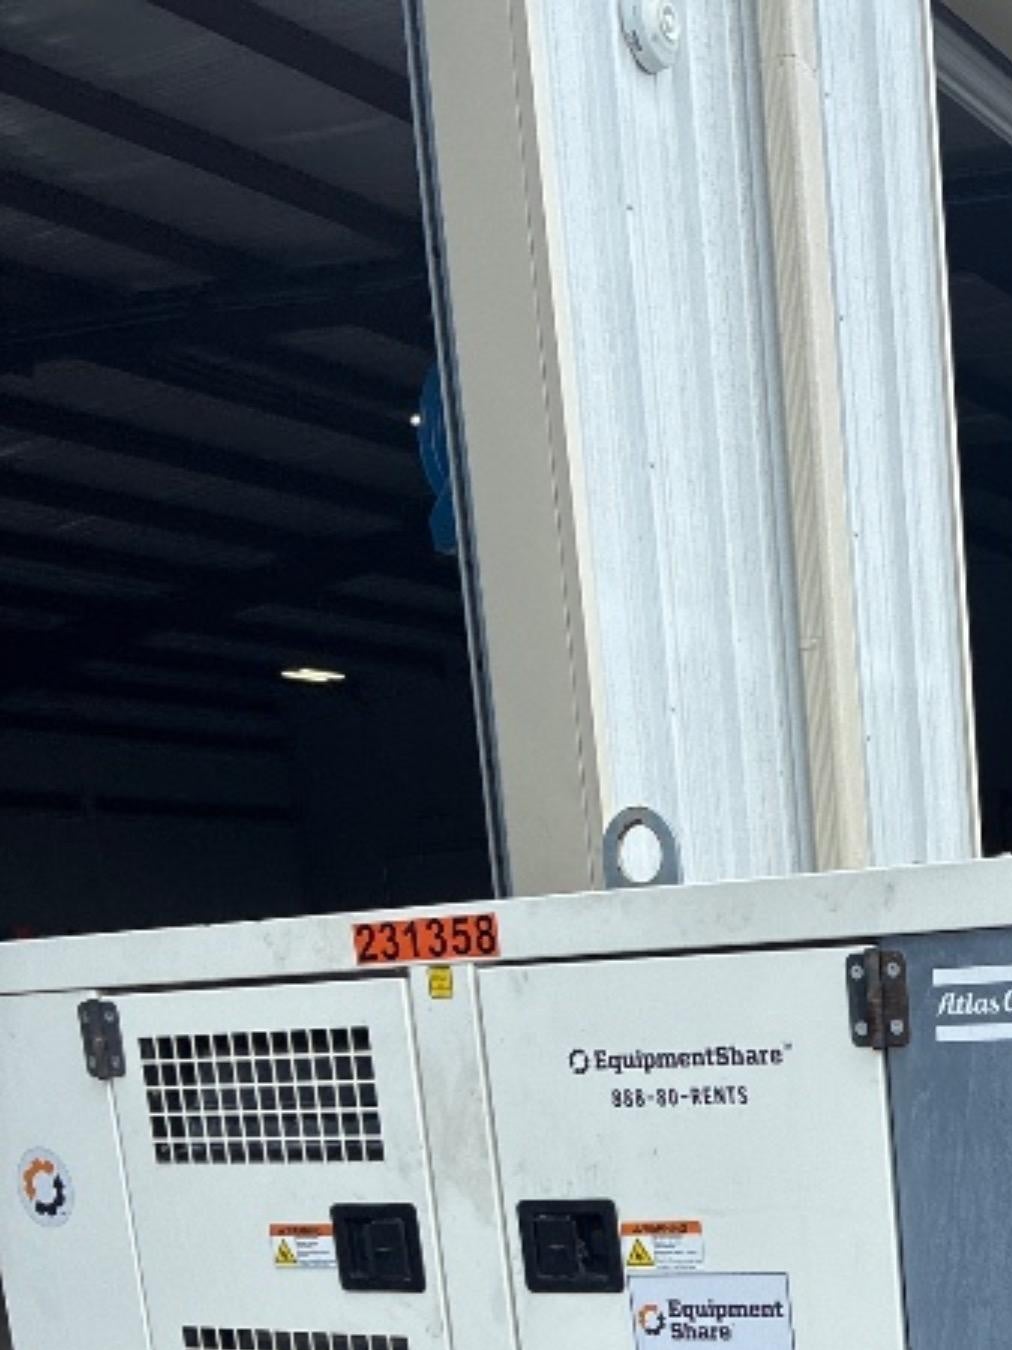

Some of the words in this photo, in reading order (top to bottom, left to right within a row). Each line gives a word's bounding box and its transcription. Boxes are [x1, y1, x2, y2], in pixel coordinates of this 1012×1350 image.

[356, 914, 496, 961] 231358
[936, 992, 1000, 1017] Atlas
[667, 1298, 784, 1323] Equipment
[670, 1323, 732, 1342] Share
